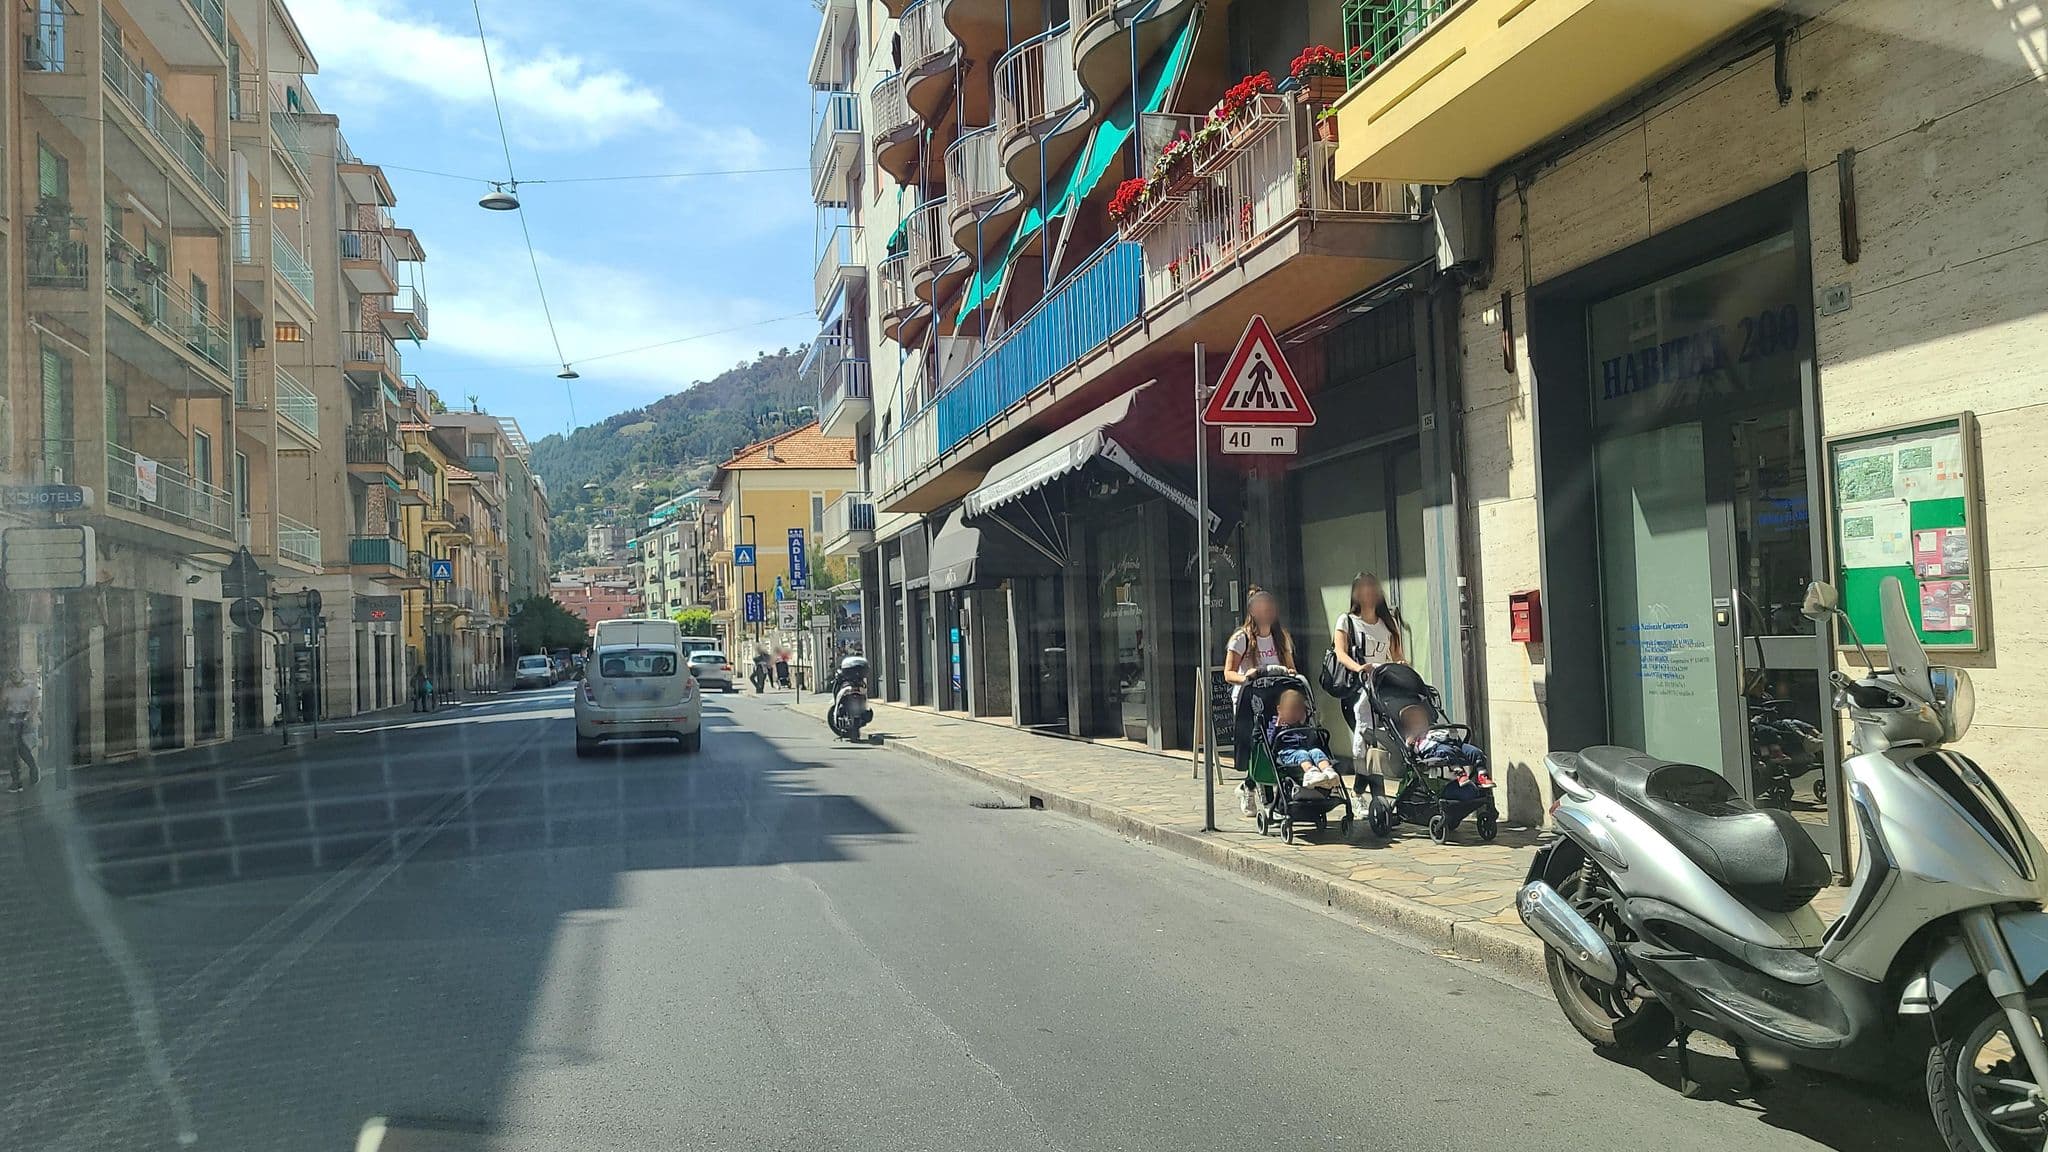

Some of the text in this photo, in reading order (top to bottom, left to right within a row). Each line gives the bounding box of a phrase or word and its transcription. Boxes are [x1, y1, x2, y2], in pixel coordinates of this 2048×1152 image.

[1229, 432, 1284, 448] 40 m
[30, 492, 81, 503] HOTELS
[792, 538, 801, 579] ADLER
